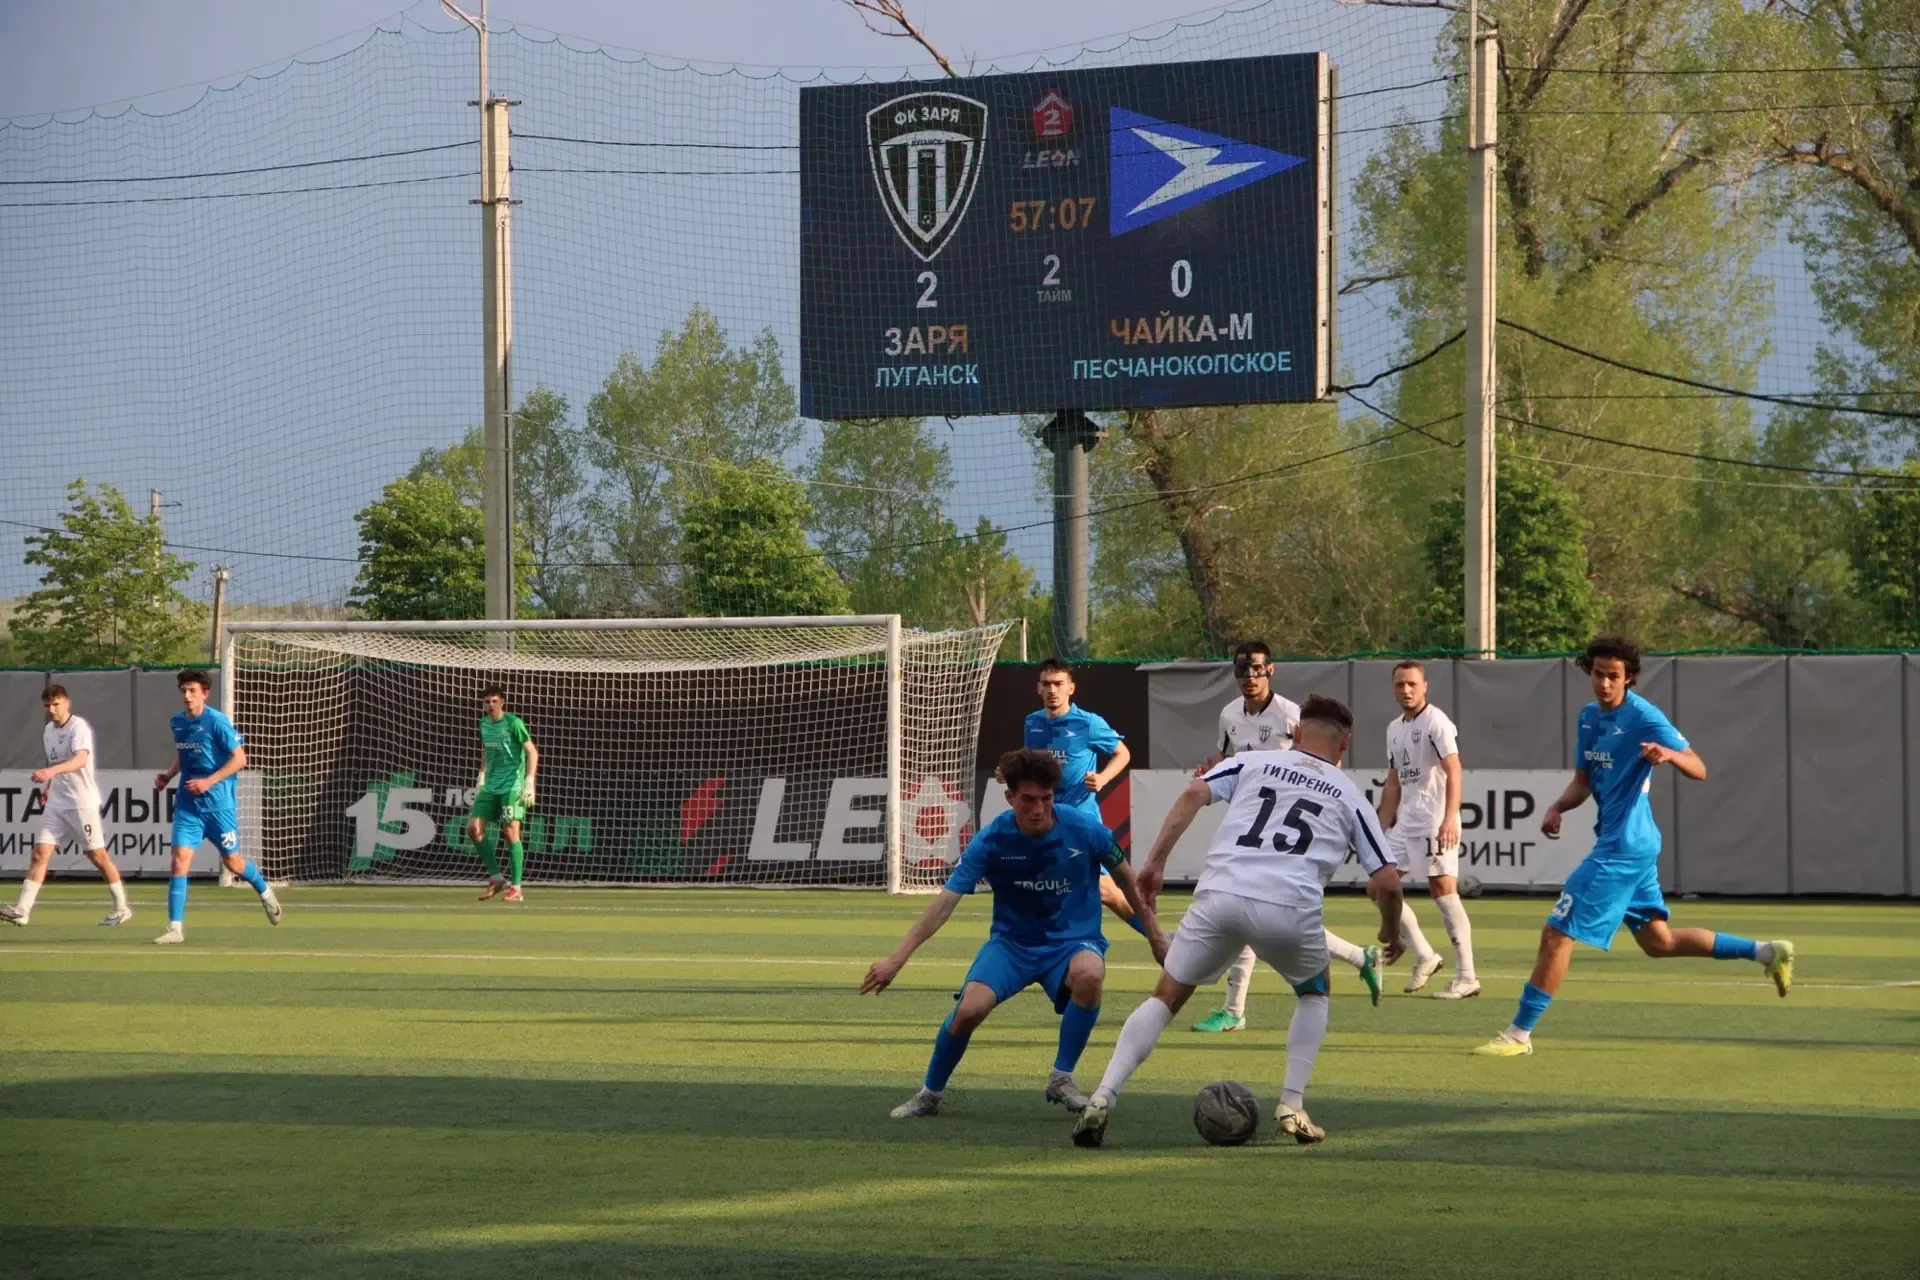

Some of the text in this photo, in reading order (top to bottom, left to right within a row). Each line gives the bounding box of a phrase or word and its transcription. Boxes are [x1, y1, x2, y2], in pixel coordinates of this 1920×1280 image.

[894, 106, 960, 126] ФК ЗАРЯ
[1023, 149, 1080, 168] LEON
[1010, 197, 1096, 232] 57:07
[1043, 254, 1061, 286] 2
[1170, 259, 1193, 298] 0
[916, 271, 938, 308] 2
[1037, 288, 1072, 303] ТАЙМ
[884, 324, 968, 356] ЗАРЯ
[1111, 310, 1253, 345] ЧАЙКА-М
[875, 364, 978, 388] ЛУГАНСК
[1073, 350, 1292, 380] ПЕСЧАНОКОПСКОЕ
[1263, 763, 1342, 799] ТИТАРЕНКО
[445, 788, 477, 806] ле
[84, 823, 92, 837] 9
[346, 788, 436, 858] 15
[1236, 786, 1324, 856] 15
[1425, 837, 1444, 857] 11
[1056, 887, 1073, 896] OIL
